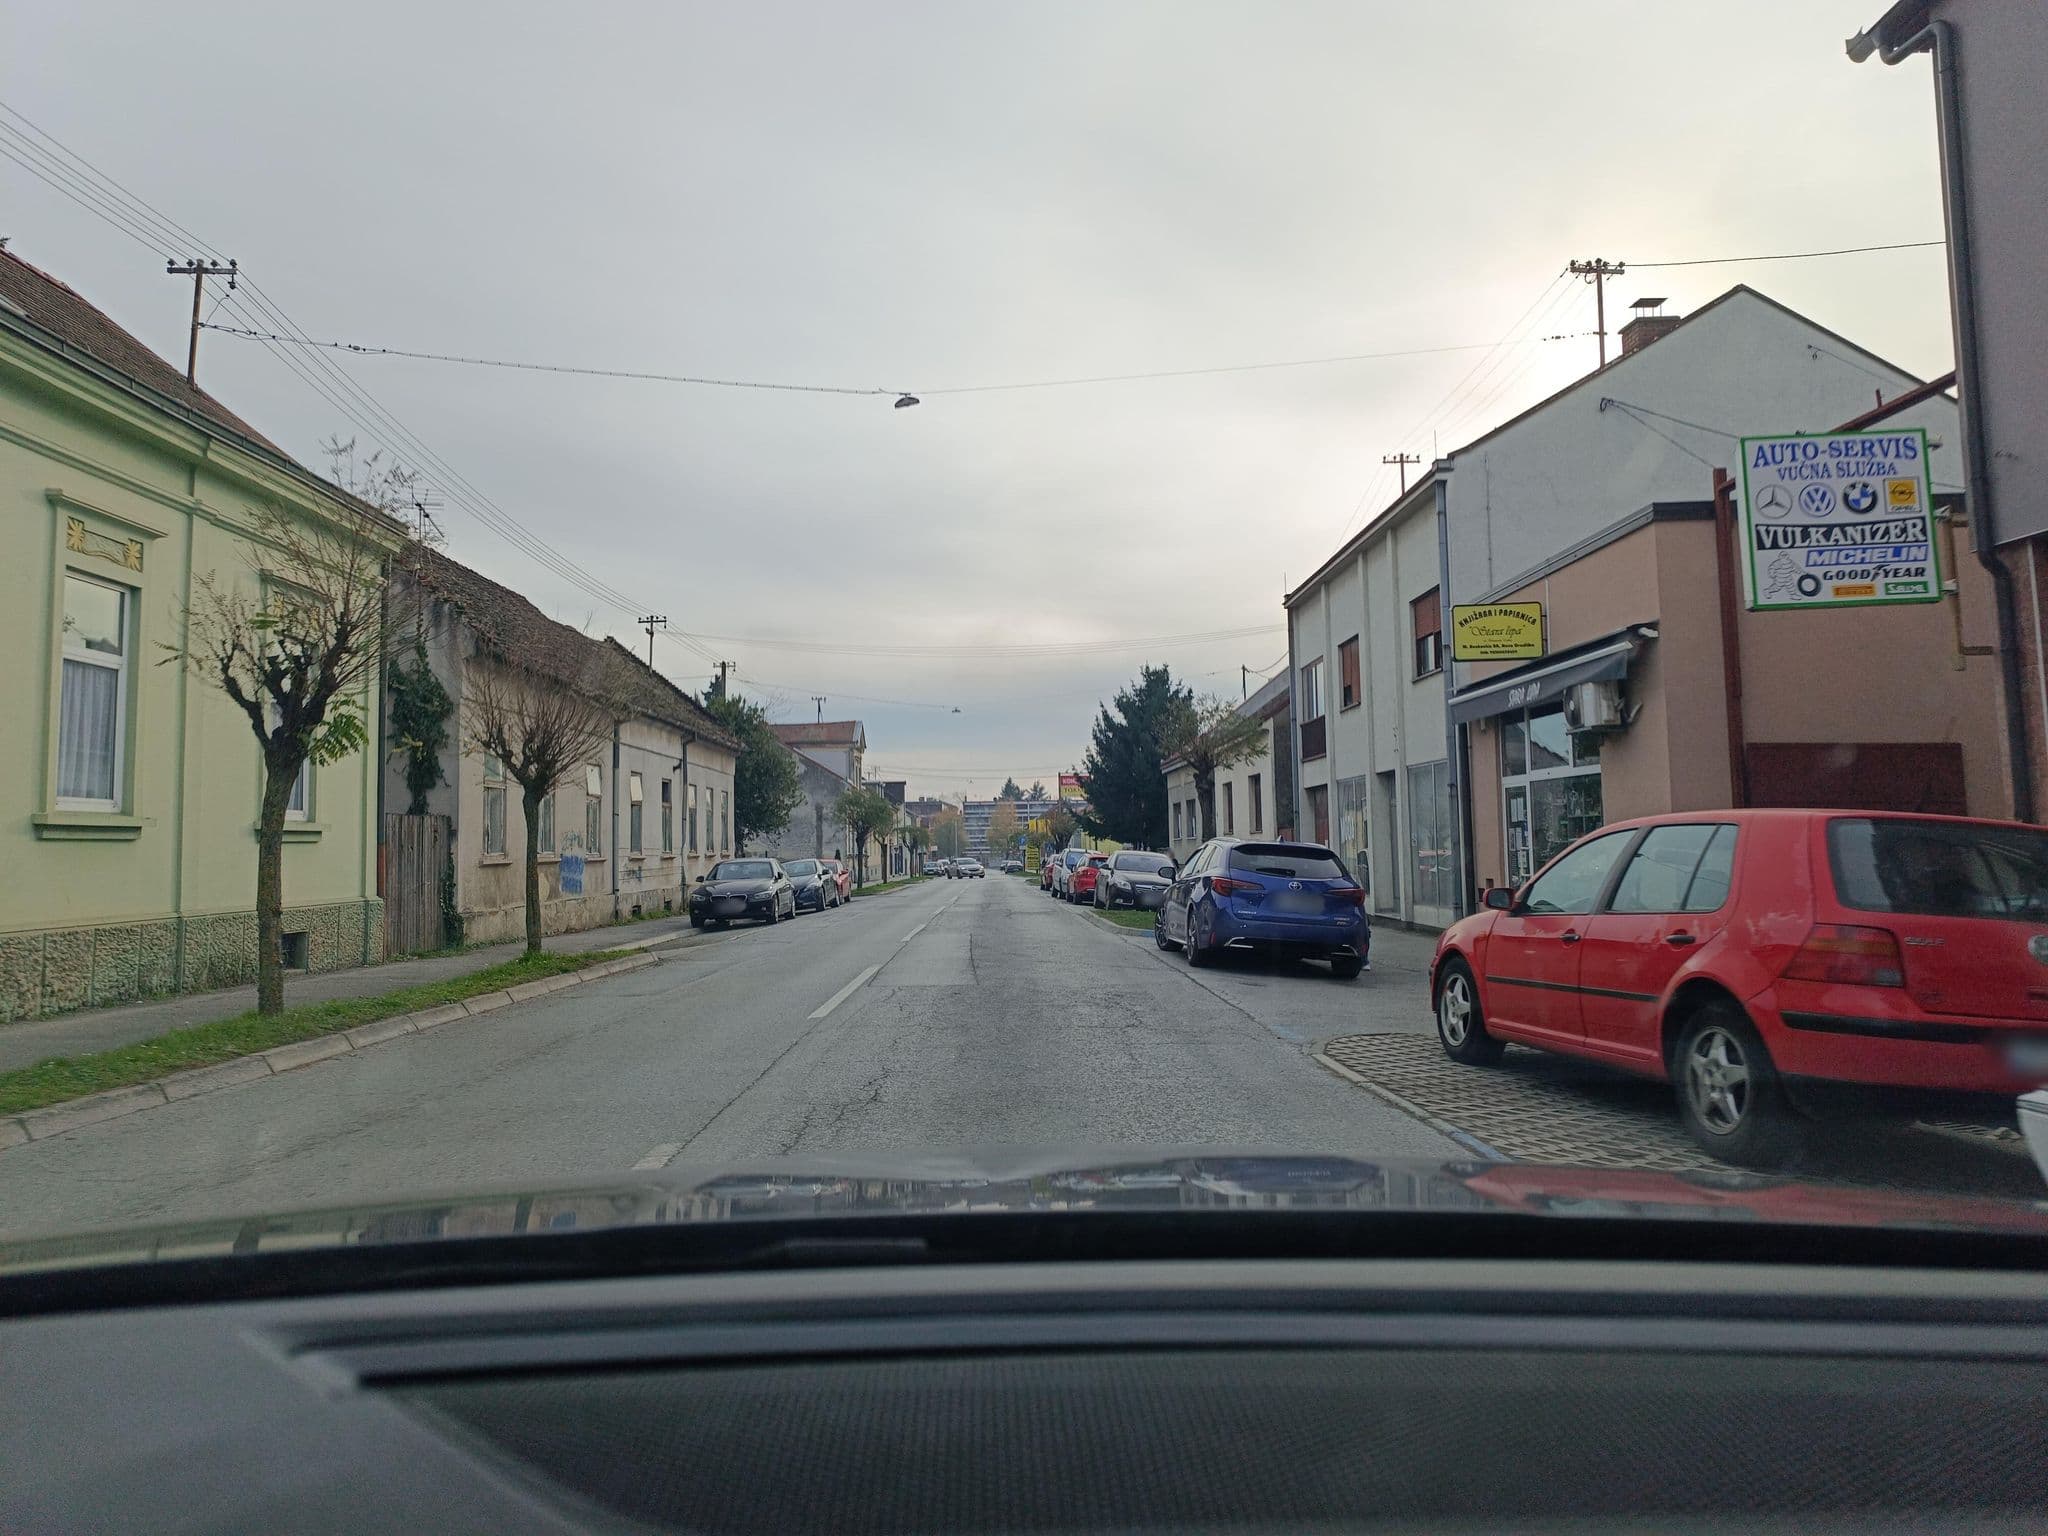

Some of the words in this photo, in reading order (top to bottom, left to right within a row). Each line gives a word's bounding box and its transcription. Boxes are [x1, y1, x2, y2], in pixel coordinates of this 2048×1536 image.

[1753, 437, 1918, 468] AUTO-SERVIS
[1757, 518, 1927, 549] VULKANIZER
[1808, 547, 1927, 566] MICHELIN
[1823, 564, 1926, 582] GOODYEAR
